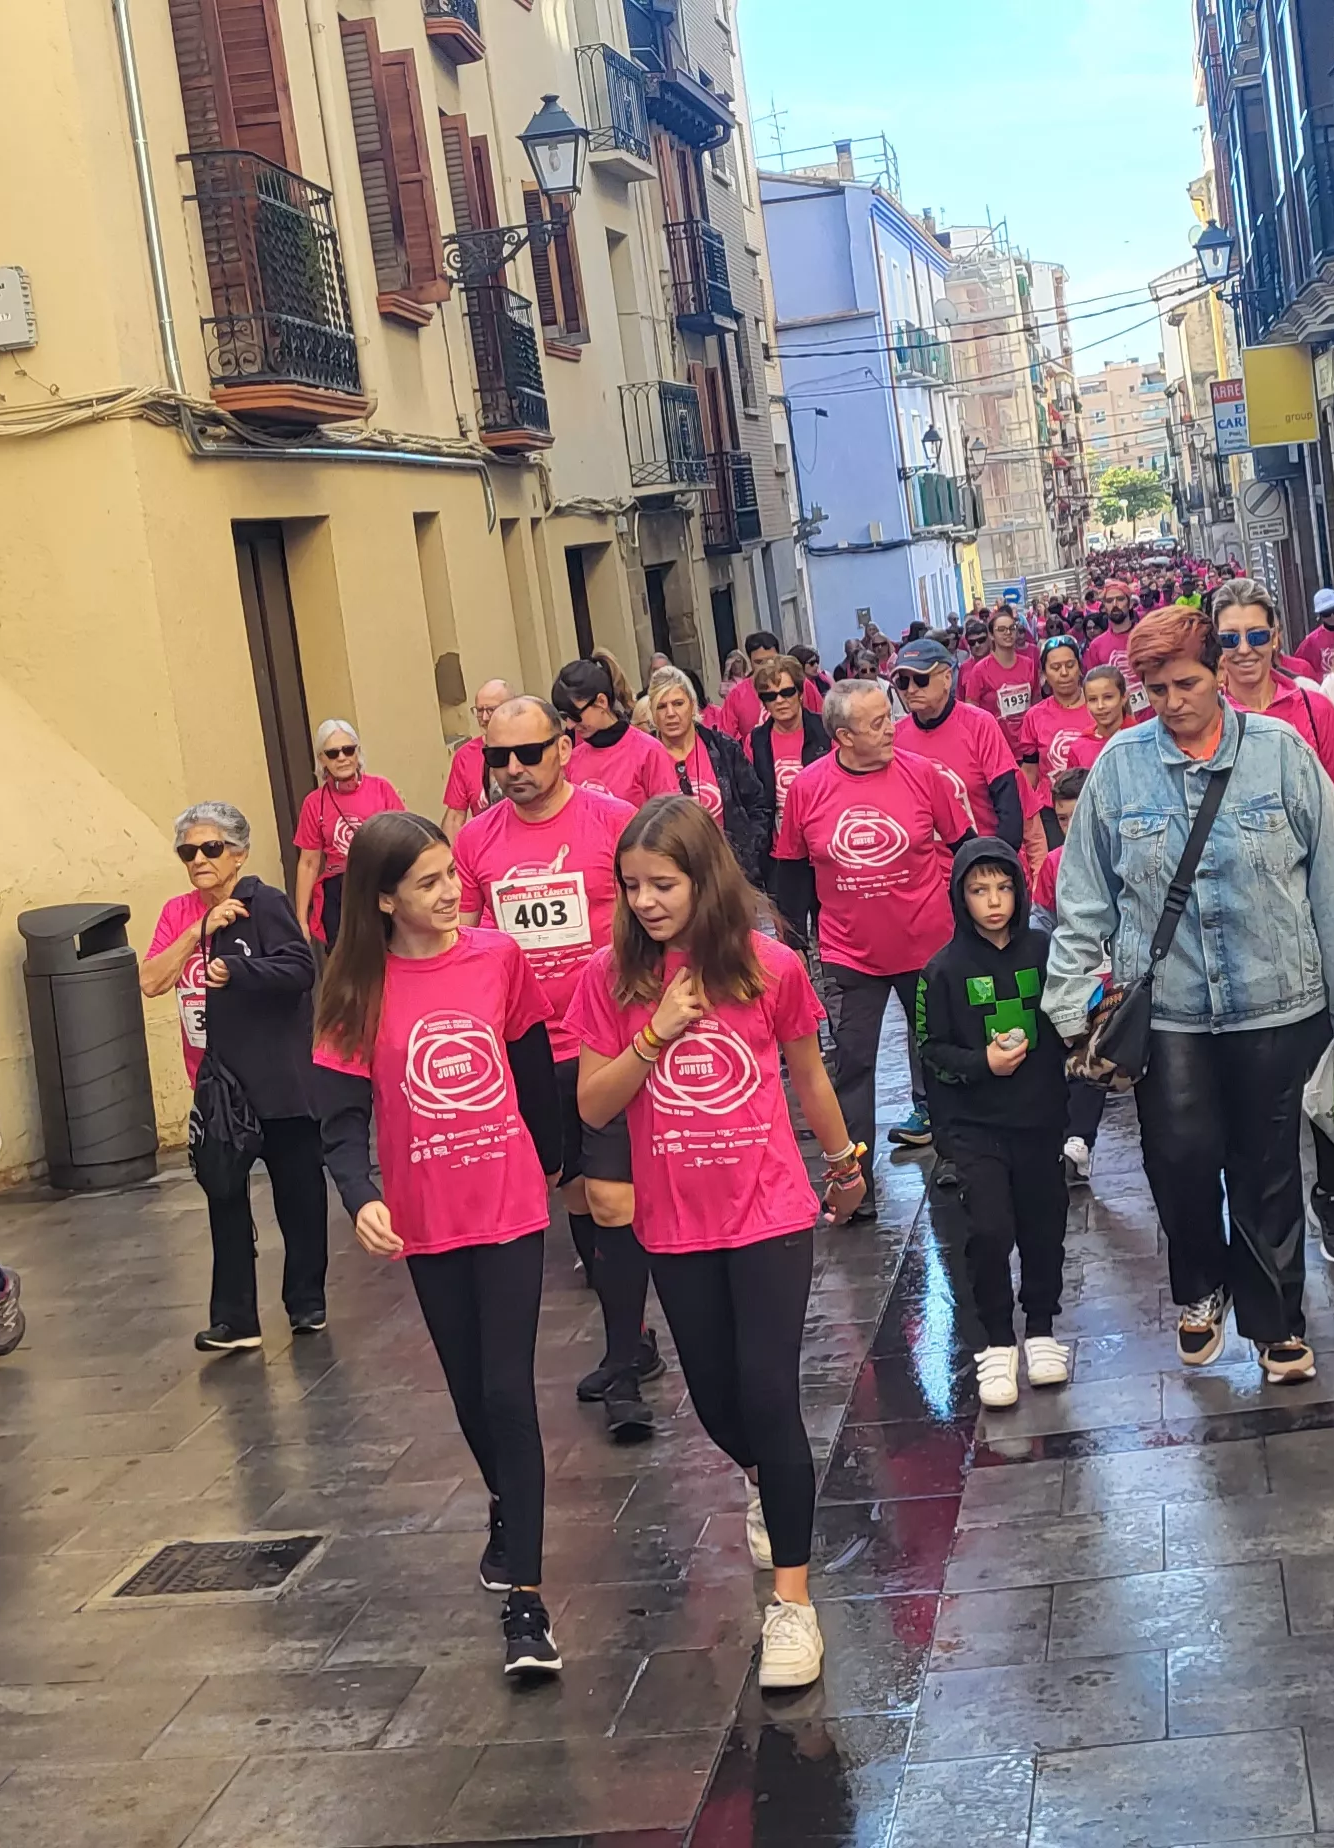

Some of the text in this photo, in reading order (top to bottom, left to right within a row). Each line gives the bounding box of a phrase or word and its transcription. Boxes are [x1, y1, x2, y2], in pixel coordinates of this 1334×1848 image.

[1213, 383, 1244, 400] ARRE
[1285, 411, 1313, 424] group
[515, 900, 568, 929] 403
